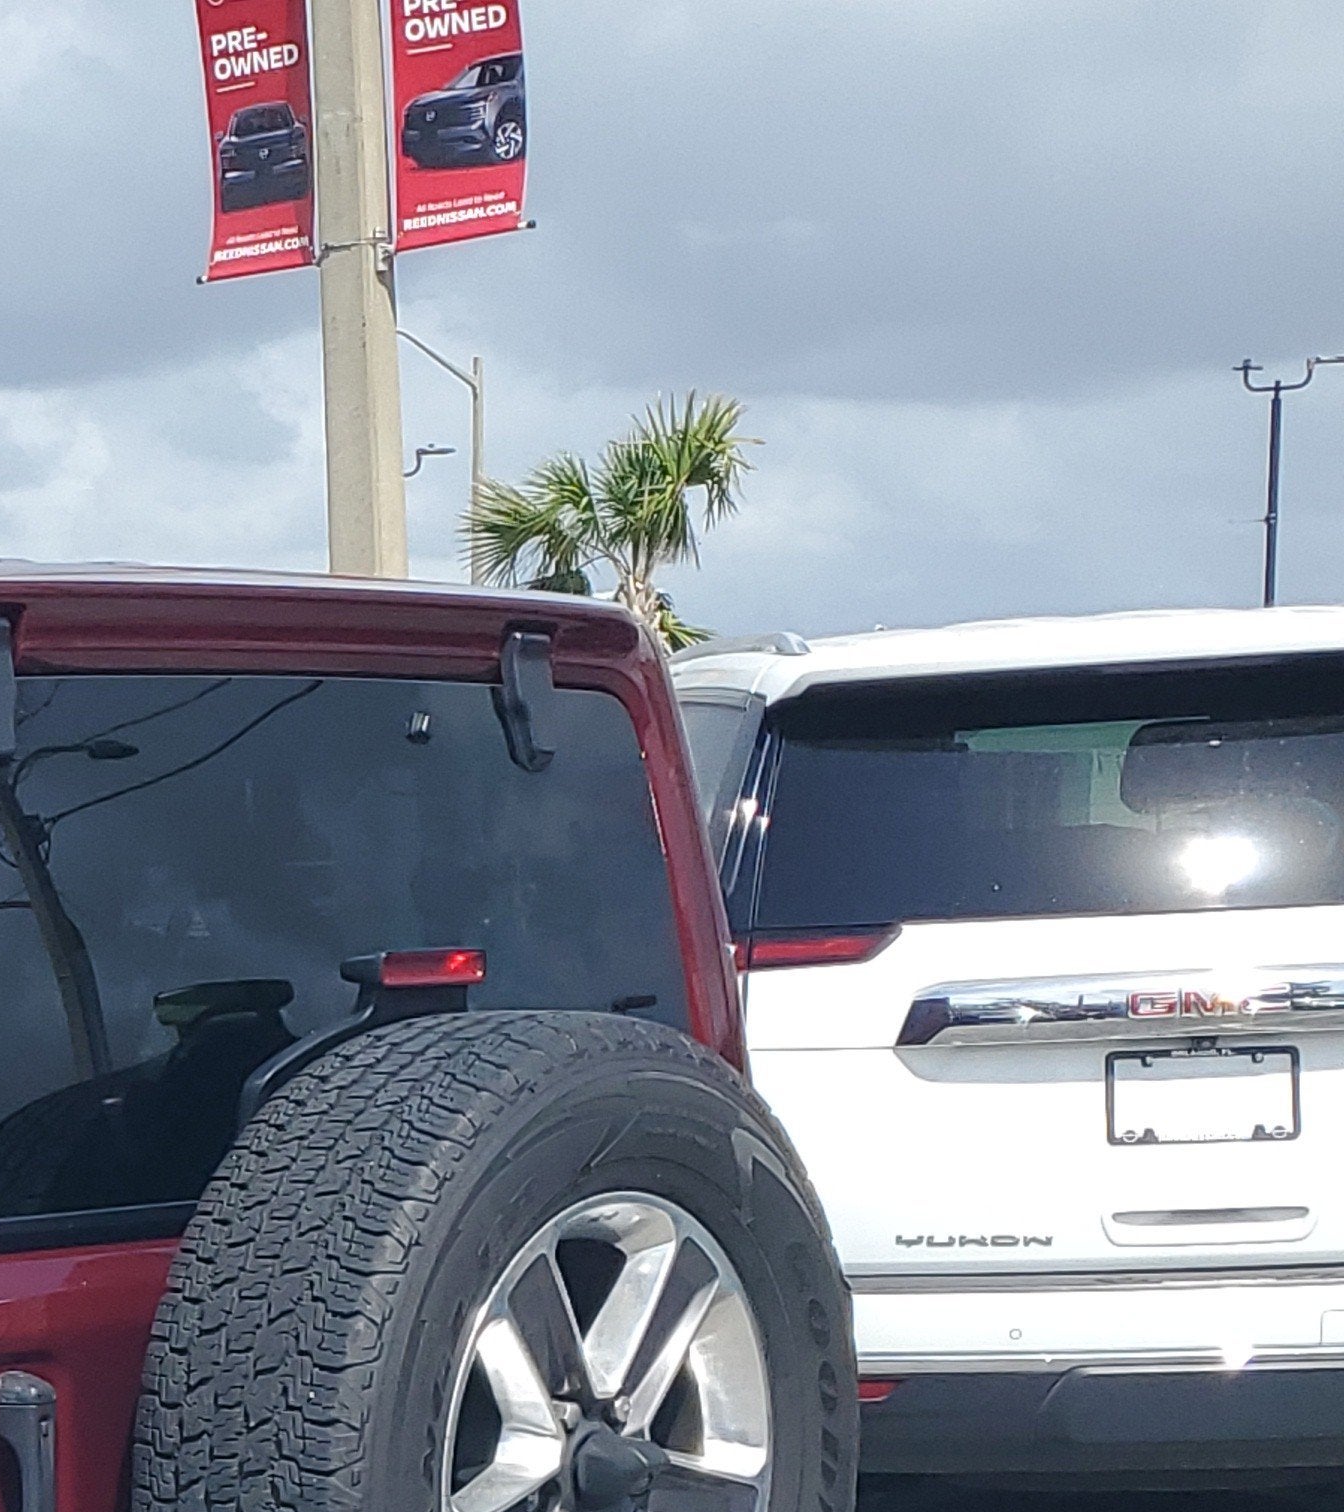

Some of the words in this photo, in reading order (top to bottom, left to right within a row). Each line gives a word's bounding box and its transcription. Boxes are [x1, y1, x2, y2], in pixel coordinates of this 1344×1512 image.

[403, 0, 466, 16] PRE
[405, 5, 507, 42] OWNED
[211, 26, 268, 57] PRE-
[214, 44, 299, 80] OWNED
[403, 201, 517, 231] REEDNISSAN.COM
[895, 1235, 1054, 1248] YUKON
